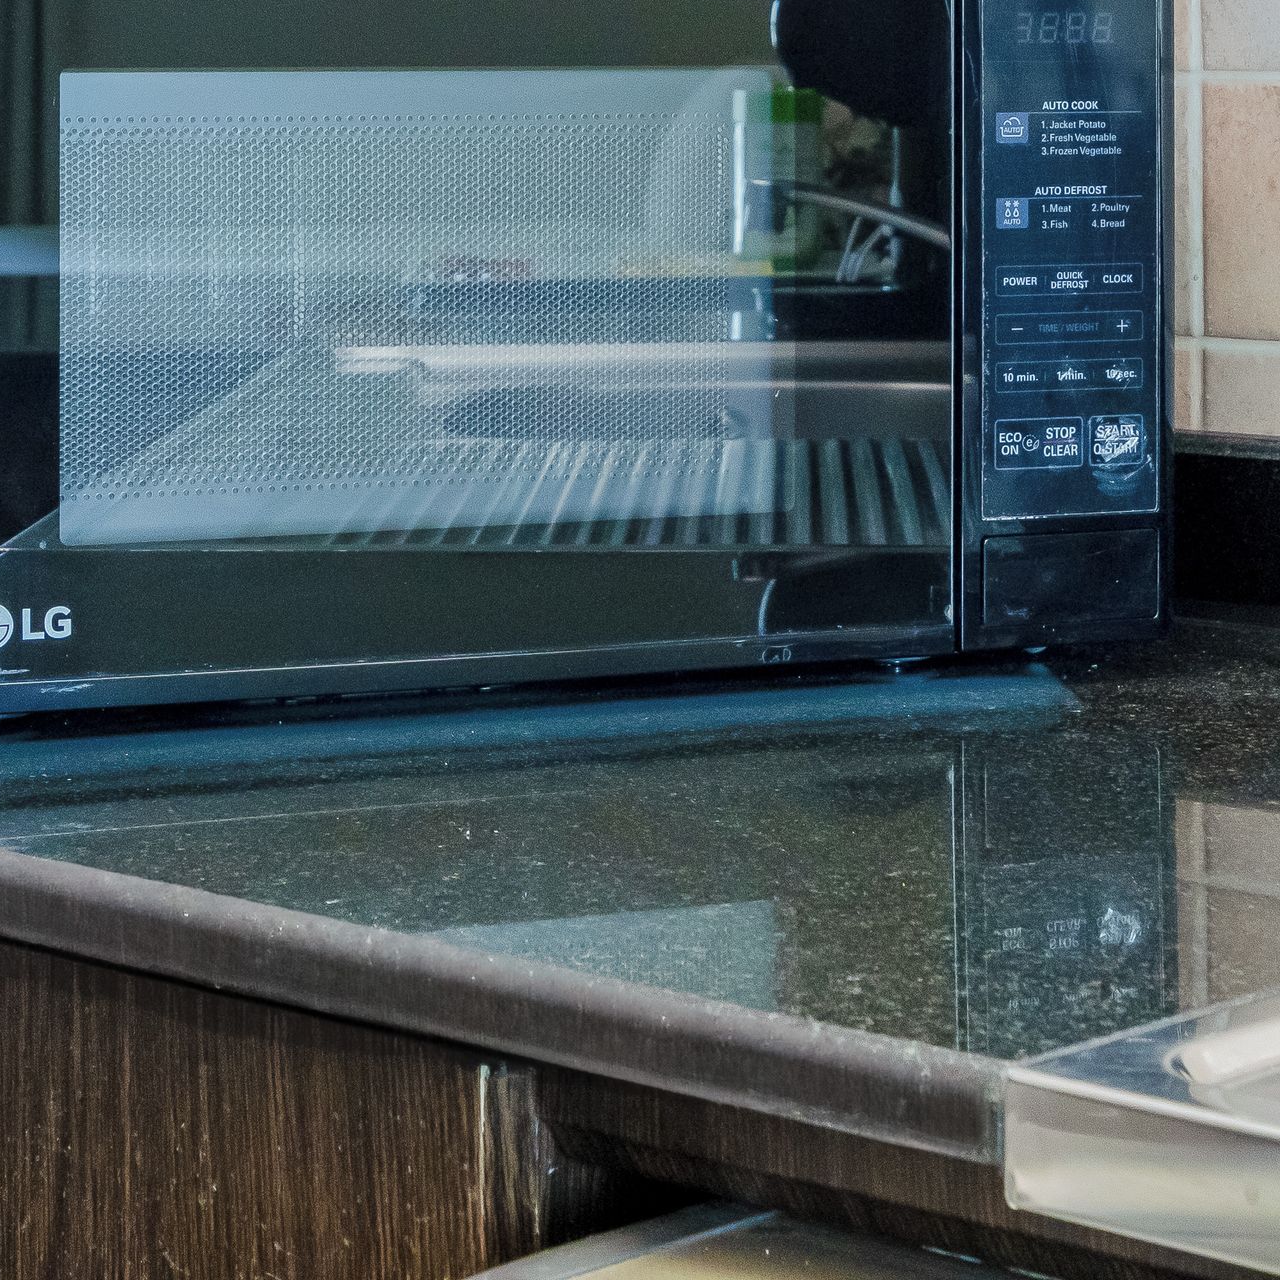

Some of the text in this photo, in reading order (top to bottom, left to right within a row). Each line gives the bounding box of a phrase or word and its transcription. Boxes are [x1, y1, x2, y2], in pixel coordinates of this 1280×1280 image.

[1042, 100, 1099, 110] AUTO COOK
[1078, 120, 1106, 129] Potato
[1074, 133, 1117, 143] Vegetable
[1079, 146, 1122, 157] Vegetable
[1034, 185, 1108, 195] AUTO DEFROST
[1056, 271, 1083, 280] QUICK
[1102, 274, 1133, 284] CLOCK
[1003, 277, 1037, 286] POWER
[1051, 280, 1089, 289] DEFROST
[1003, 372, 1039, 382] 10 min.
[999, 432, 1022, 443] ECO
[1046, 427, 1076, 439] STOP
[1001, 445, 1019, 455] ON
[1043, 445, 1078, 457] CLEAR
[22, 605, 72, 640] LG
